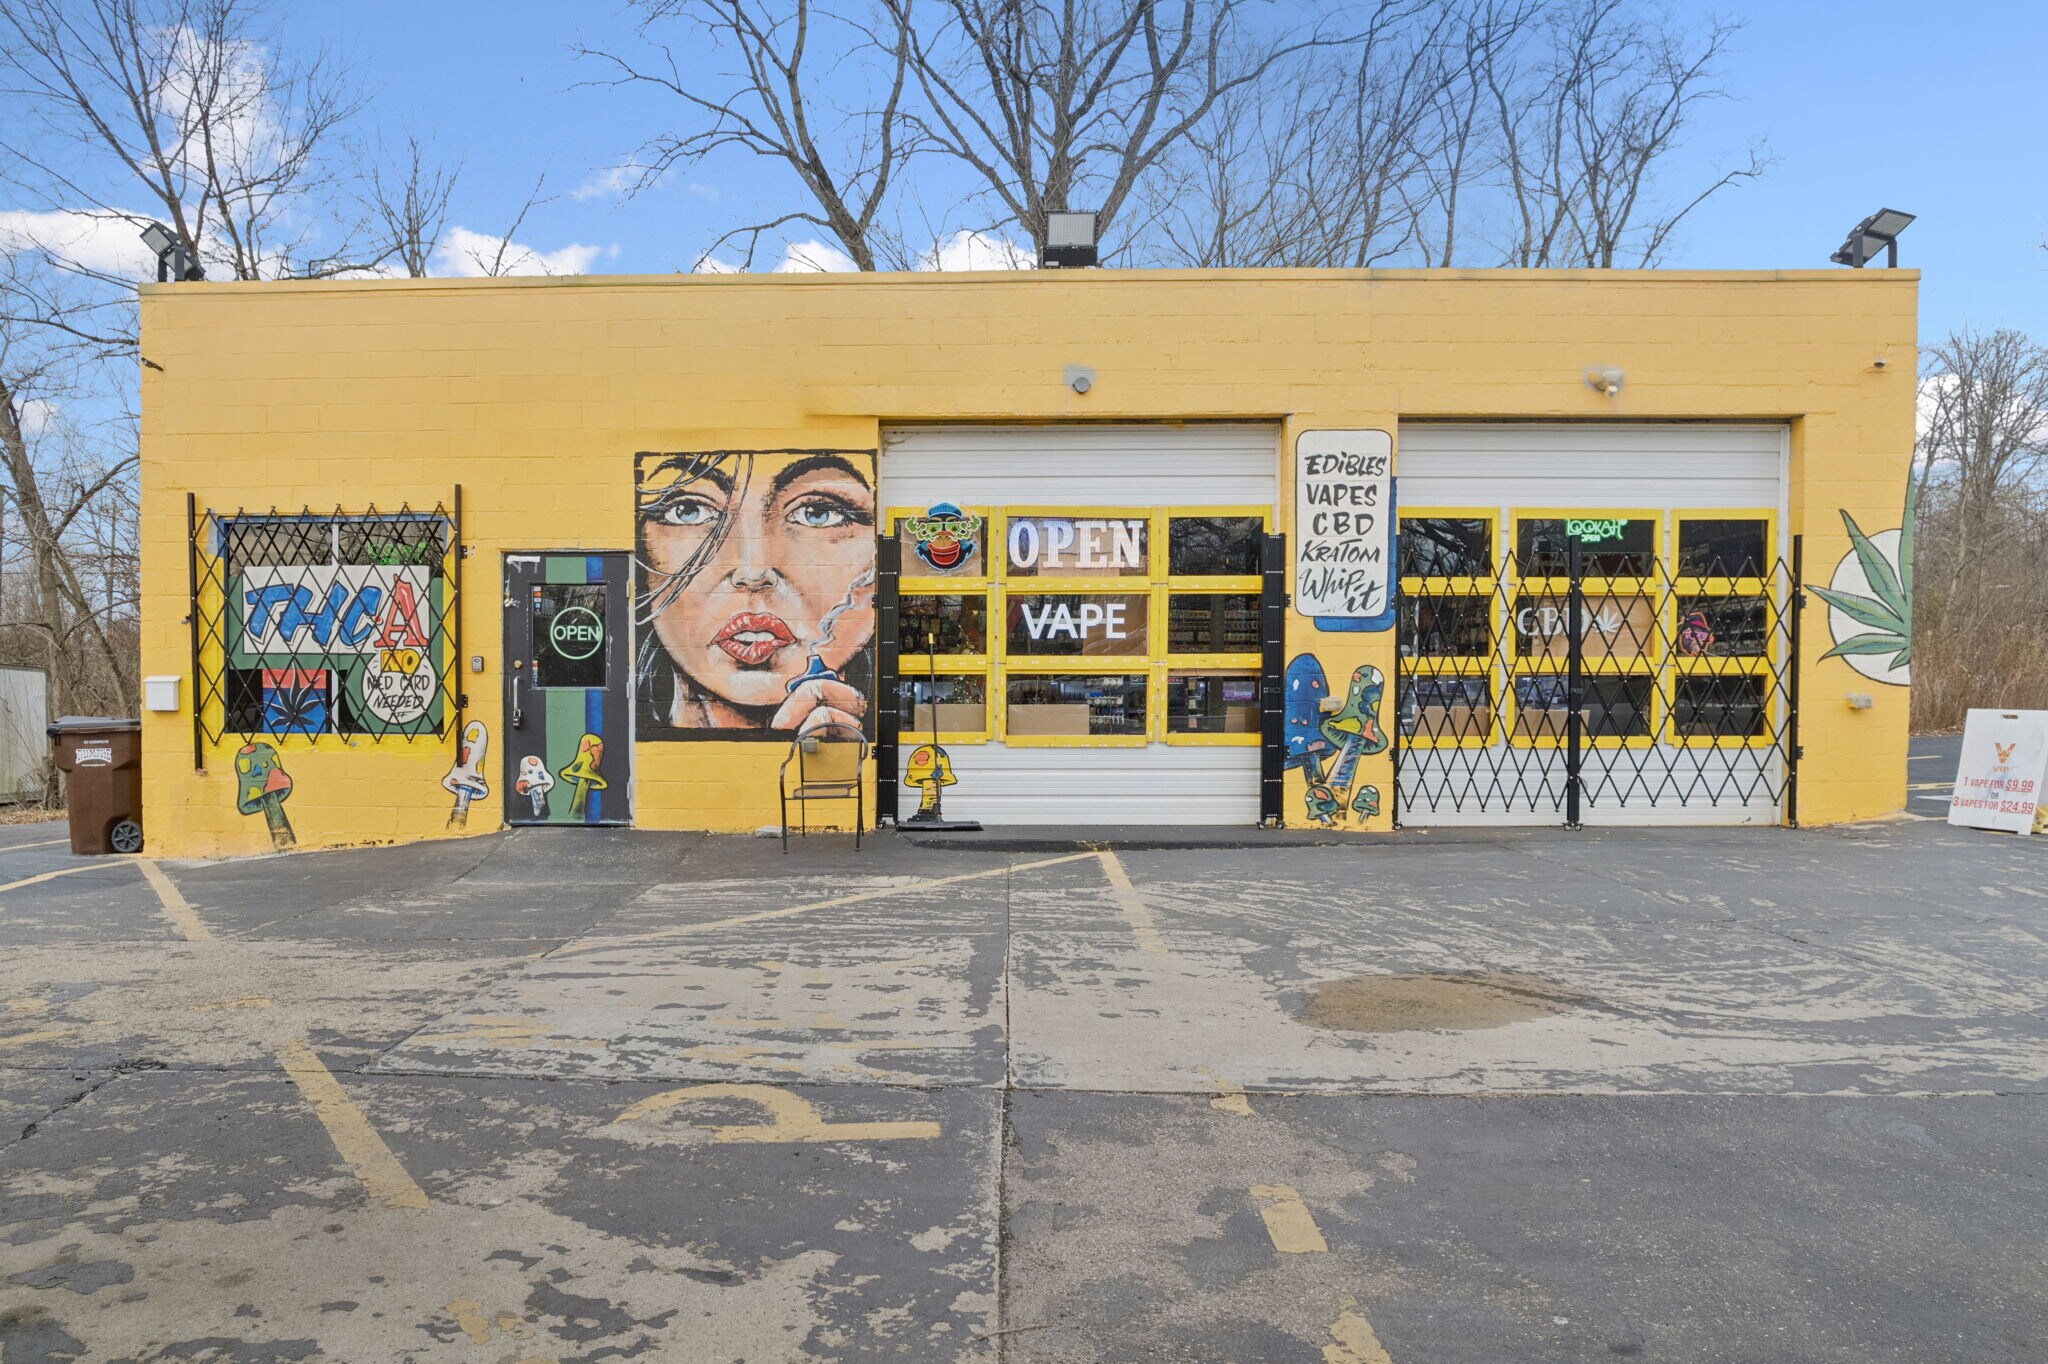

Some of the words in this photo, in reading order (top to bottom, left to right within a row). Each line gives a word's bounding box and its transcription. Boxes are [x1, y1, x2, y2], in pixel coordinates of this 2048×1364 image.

[1306, 483, 1377, 507] VAPES
[1312, 511, 1374, 536] CBD
[1008, 519, 1144, 568] OPEN
[1300, 538, 1381, 563] KRATOM
[553, 625, 600, 641] OPEN
[1021, 603, 1126, 640] VAPE
[1516, 607, 1592, 636] CBD
[380, 648, 421, 675] NO
[373, 694, 424, 710] NEEDED
[1970, 778, 1989, 789] VAPE
[1989, 779, 2005, 790] FOR
[2005, 778, 2035, 793] $9.99
[1952, 795, 1960, 807] 3
[1961, 799, 1984, 809] VAPES
[1984, 800, 1999, 810] FOR
[2000, 800, 2035, 815] $24.99
